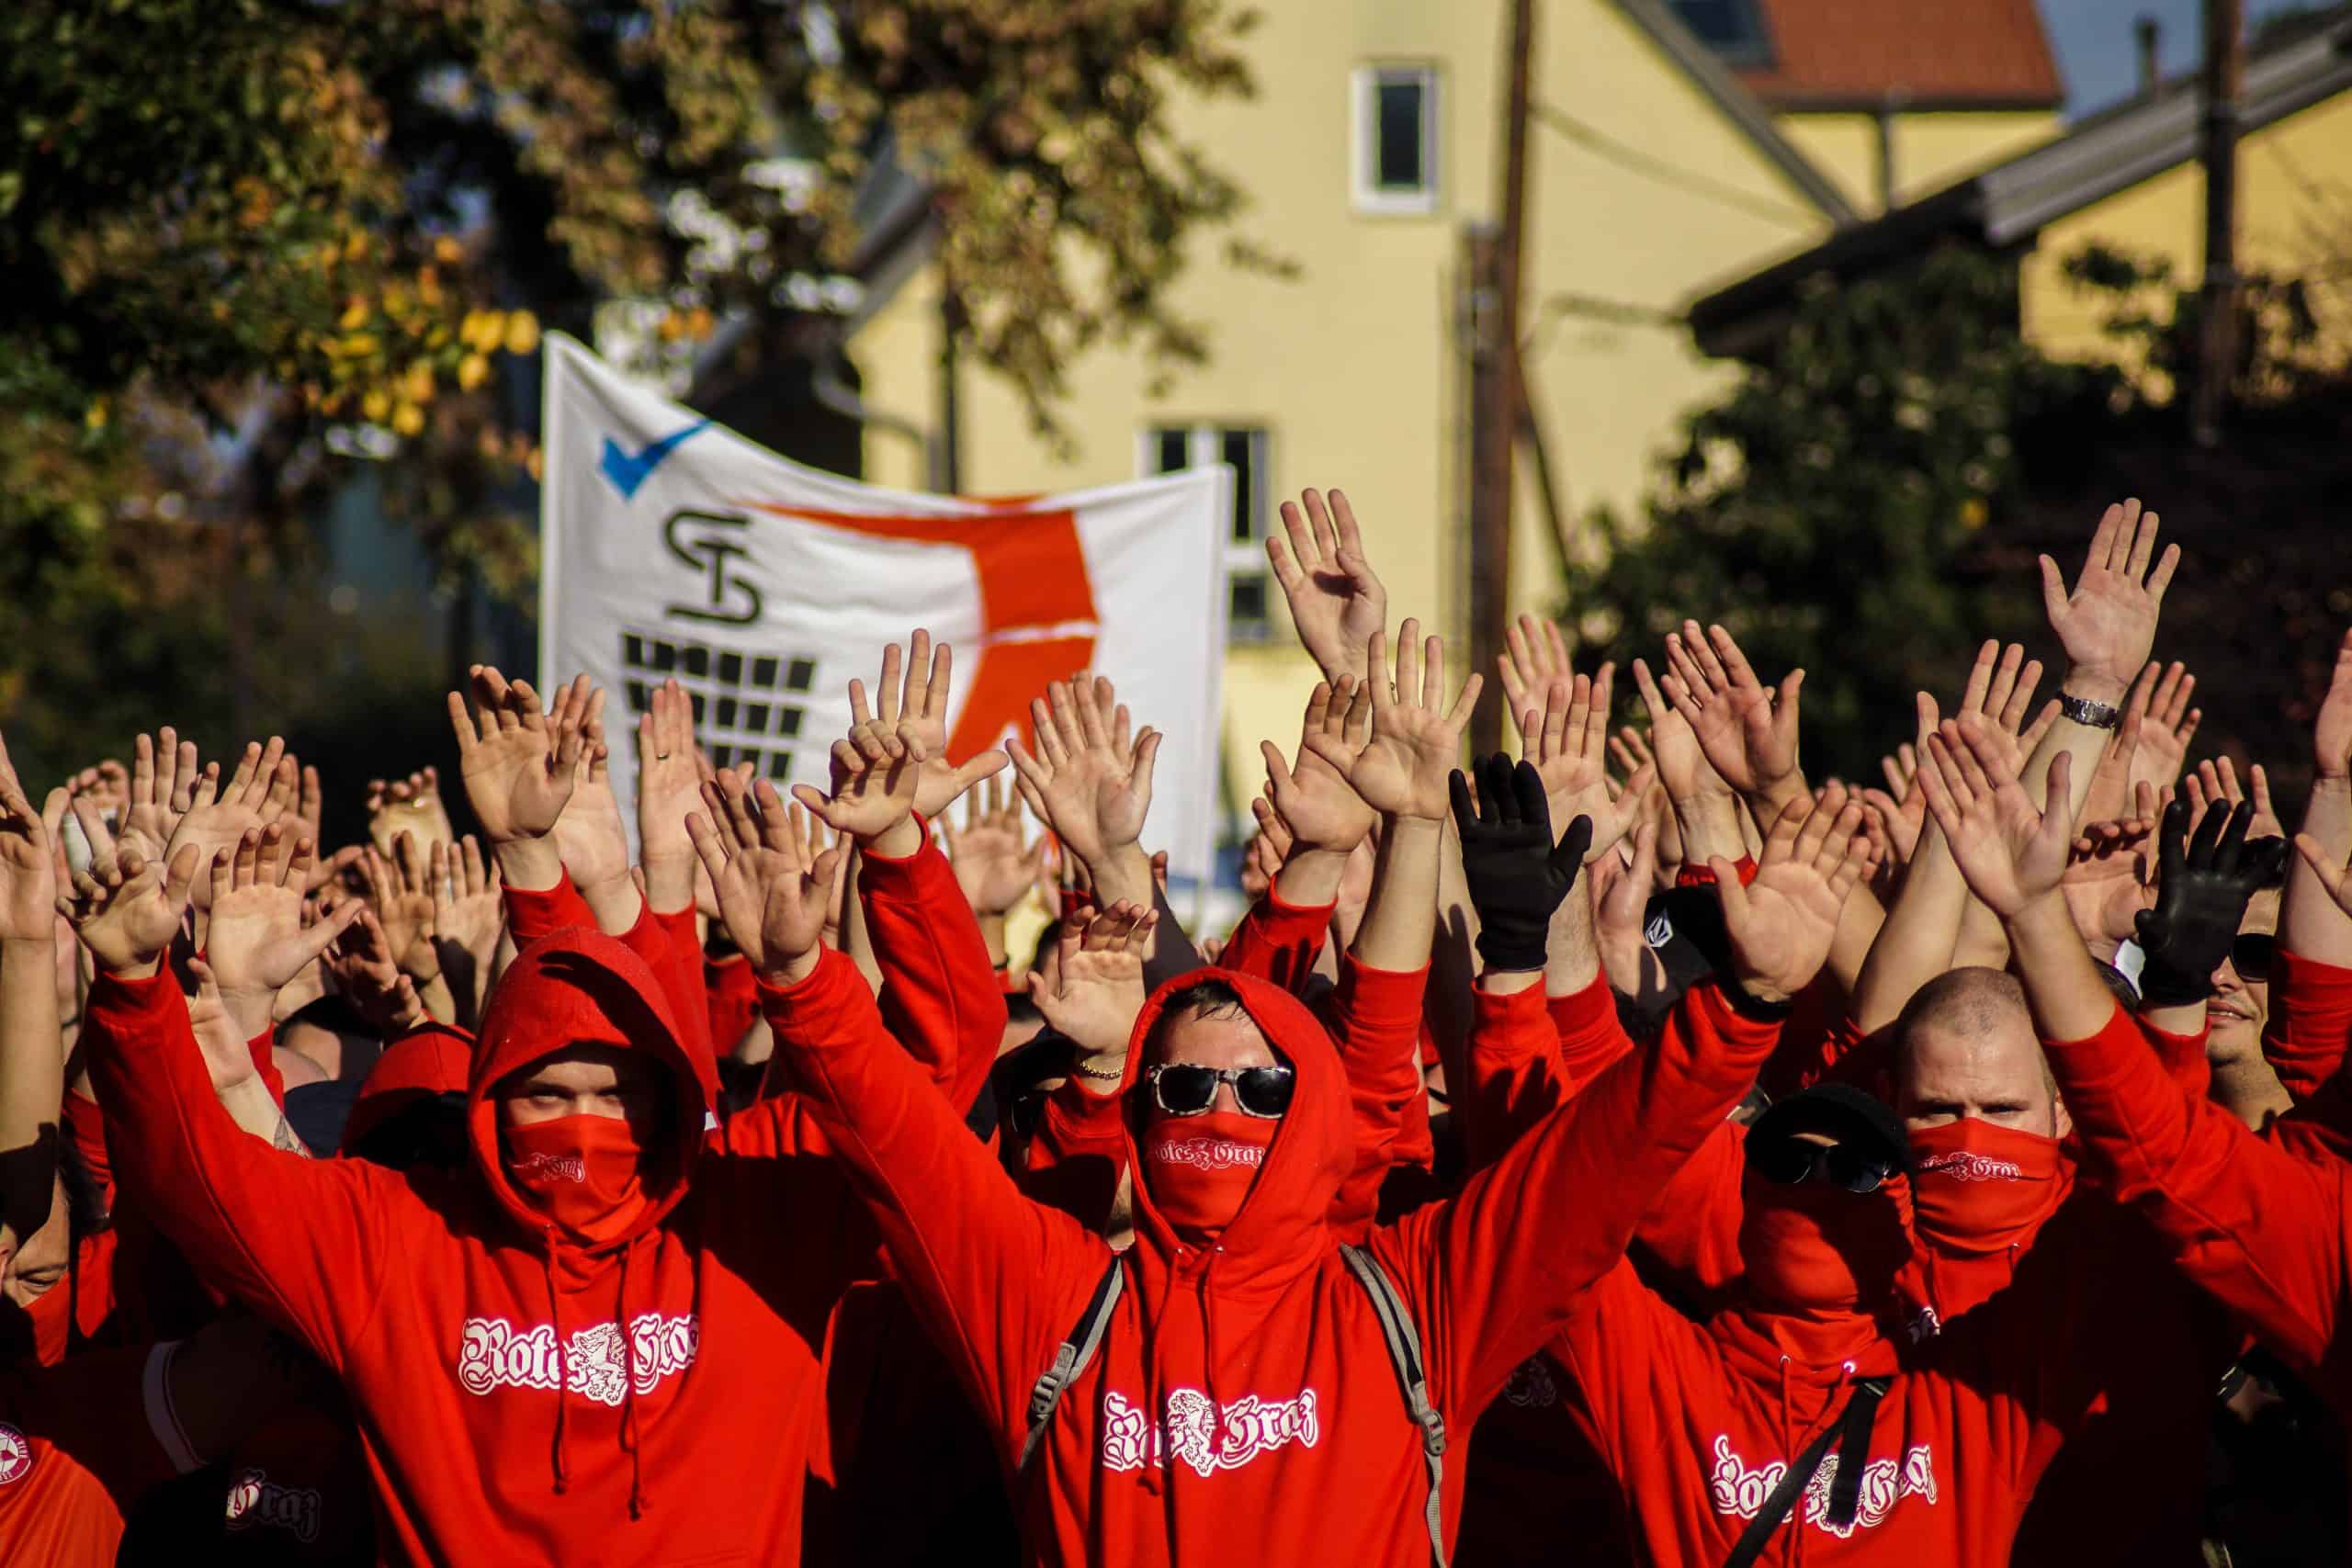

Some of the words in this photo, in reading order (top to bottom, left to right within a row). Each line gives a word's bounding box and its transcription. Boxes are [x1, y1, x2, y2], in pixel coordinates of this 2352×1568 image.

[1152, 1140, 1196, 1164] otes
[629, 1314, 698, 1394] Gra
[1218, 1389, 1317, 1470] Graz
